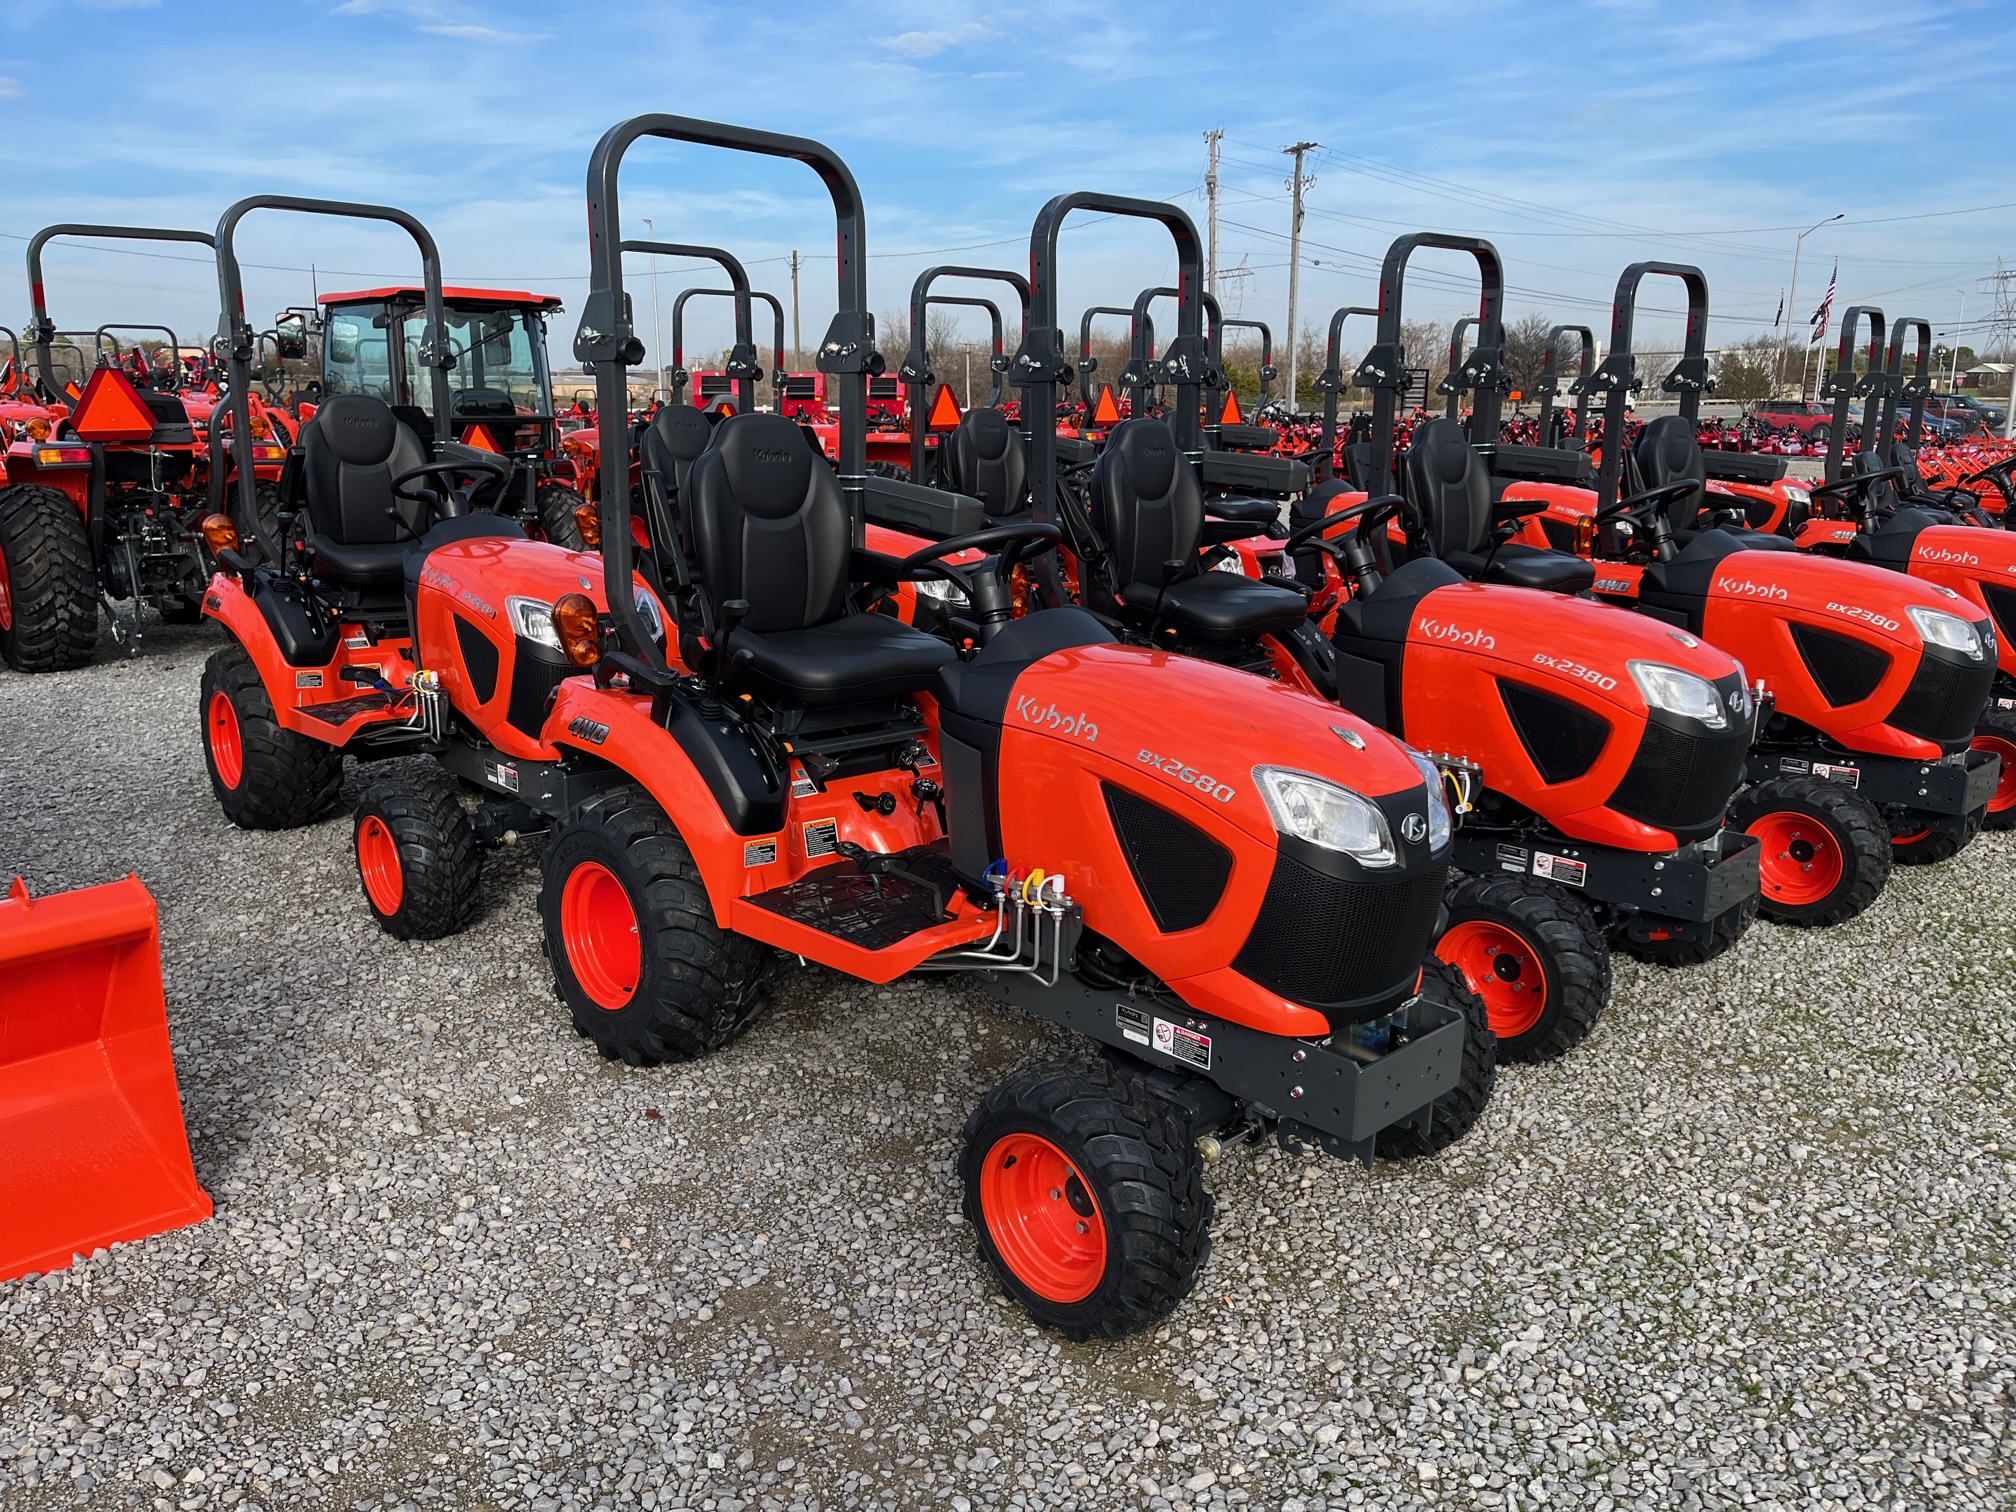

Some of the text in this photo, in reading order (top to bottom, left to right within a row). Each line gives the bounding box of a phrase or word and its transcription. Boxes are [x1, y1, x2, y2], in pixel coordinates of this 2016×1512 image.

[753, 448, 792, 463] Kubota
[1918, 546, 1979, 565] Kubota
[1593, 579, 1632, 593] 4WD
[1718, 577, 1788, 600] Kubota
[1826, 602, 1901, 632] BX2380
[1419, 618, 1495, 650] Kubota
[1532, 653, 1618, 691] BX2380
[567, 716, 611, 746] 4WD
[1016, 694, 1098, 742] Kubota
[1136, 748, 1236, 803] BX2680
[1180, 1029, 1201, 1042] DANGER
